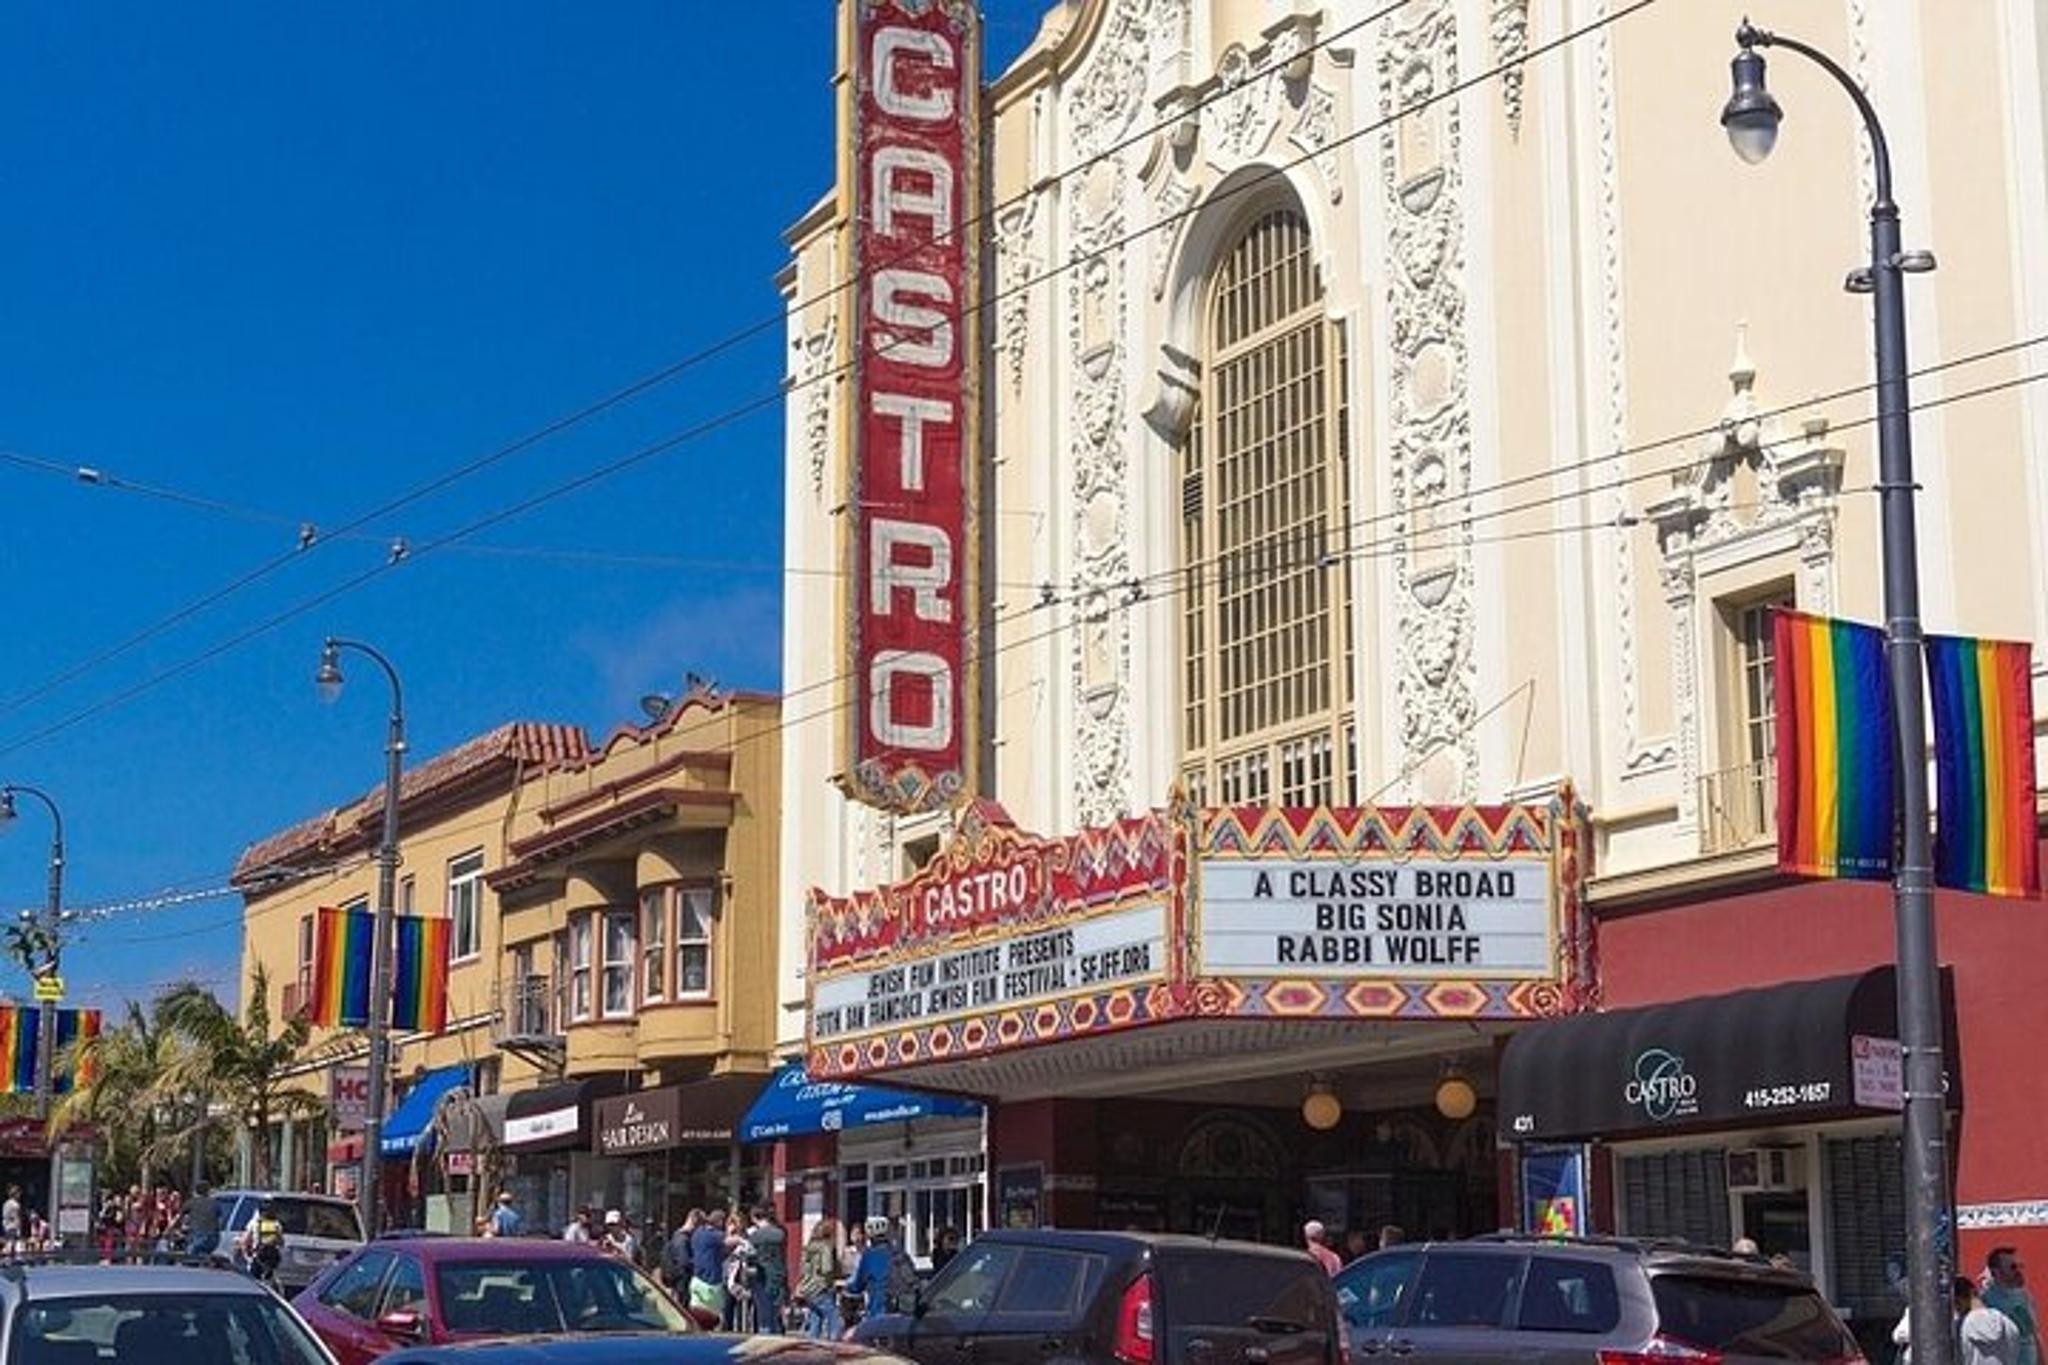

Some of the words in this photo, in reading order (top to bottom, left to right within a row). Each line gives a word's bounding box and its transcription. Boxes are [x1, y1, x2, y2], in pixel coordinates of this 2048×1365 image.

[871, 26, 954, 751] CASTRO
[925, 864, 1026, 925] CASTRO
[1253, 870, 1274, 898] A
[1289, 870, 1398, 898] CLASSY
[1415, 870, 1515, 898] BROAD
[1316, 903, 1366, 931] BIG
[1376, 903, 1467, 931] SONIA
[867, 968, 905, 999] JEWISH
[910, 957, 936, 992] FILM
[939, 946, 1000, 983] INSTITUTE
[1009, 929, 1075, 967] PRESENTS
[1276, 935, 1372, 963] RABBI
[1385, 935, 1481, 963] WOLFF
[927, 981, 969, 1013] JEWISH
[972, 976, 997, 1005] FILM
[1003, 963, 1067, 999] FESTIVAL
[1080, 943, 1150, 983] SFJFF.ORG
[1624, 1073, 1697, 1105] CASTRO
[628, 1120, 670, 1147] DESIGN
